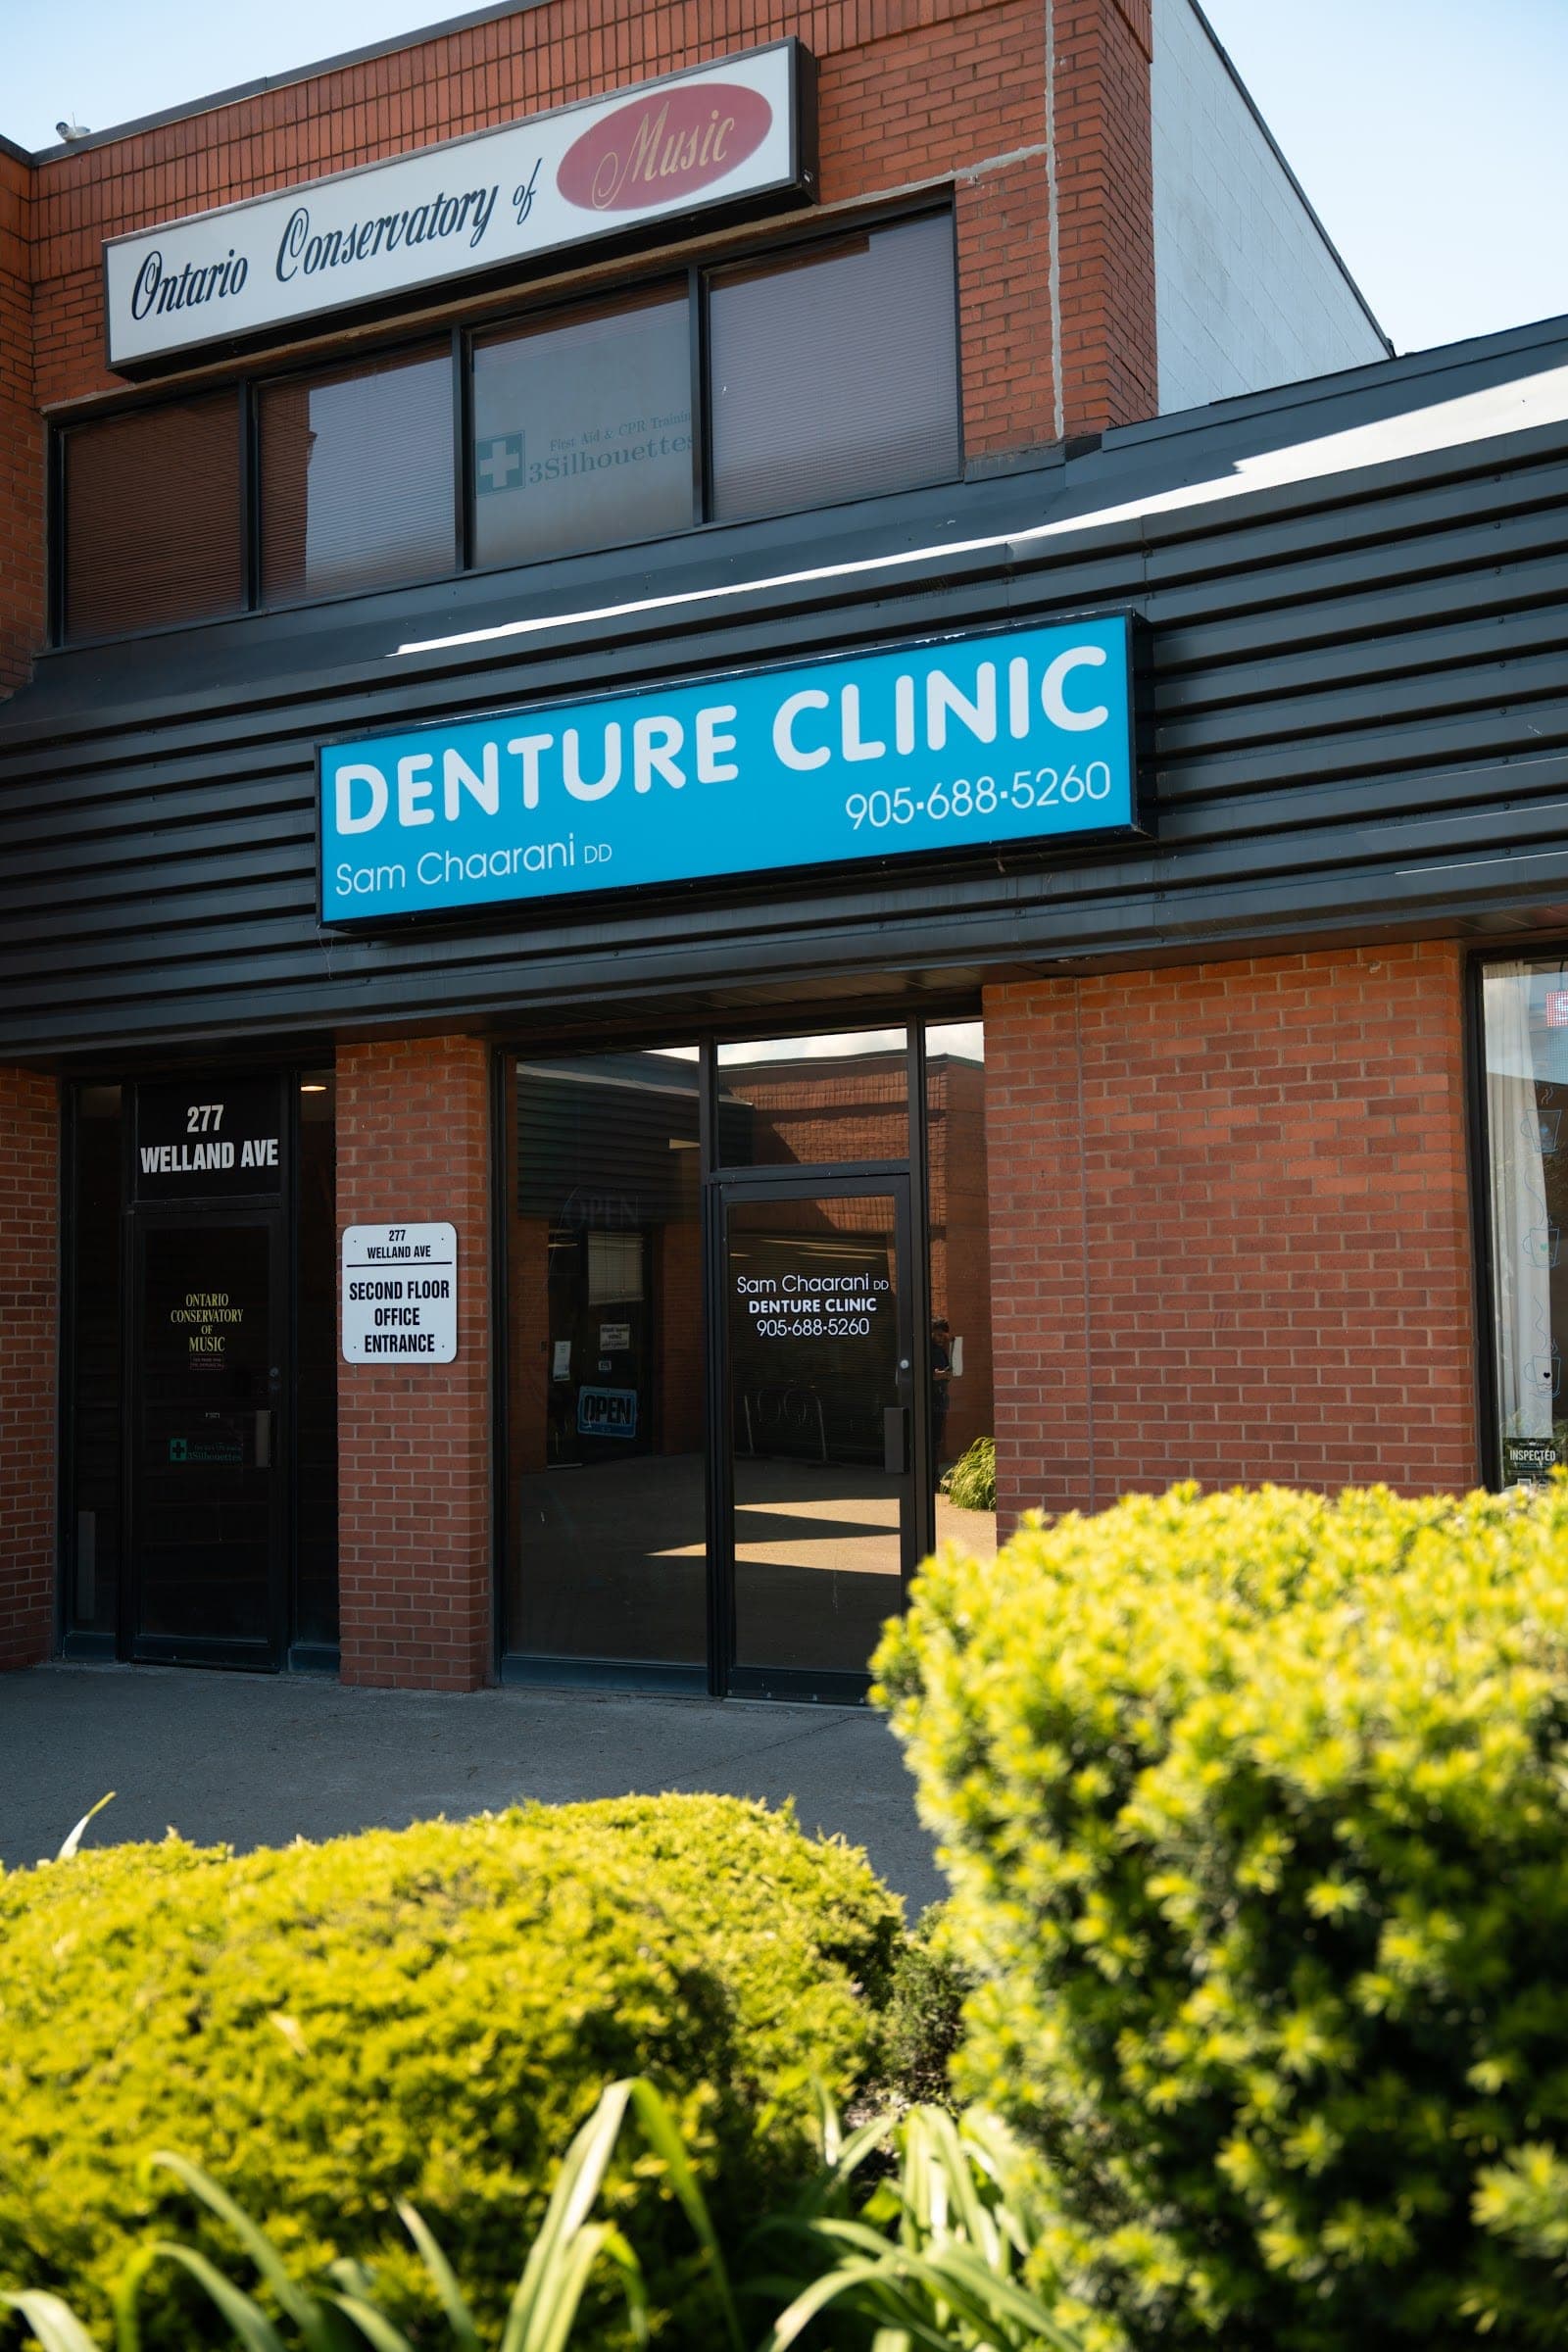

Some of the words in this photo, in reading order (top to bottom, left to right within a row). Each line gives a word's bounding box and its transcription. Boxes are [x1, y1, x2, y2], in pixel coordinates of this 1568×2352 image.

[130, 249, 249, 321] Ontario
[275, 184, 500, 282] Conservatory
[513, 158, 543, 225] of
[591, 100, 735, 210] Music
[549, 437, 575, 452] First
[580, 428, 600, 445] Aid
[603, 429, 614, 440] &
[618, 418, 647, 436] CPR
[650, 410, 691, 430] Trainin
[335, 705, 740, 835] DENTURE
[772, 646, 1109, 771] CLINIC
[336, 863, 406, 896] Sam
[417, 833, 574, 885] Chaarani
[583, 843, 612, 863] DD
[186, 1103, 224, 1133] 277
[140, 1142, 235, 1174] WELLAND
[240, 1138, 279, 1168] AVE
[388, 1229, 407, 1242] 277
[368, 1246, 412, 1259] WELLAND
[414, 1245, 431, 1257] AVE
[349, 1281, 403, 1300] SECOND
[407, 1280, 450, 1299] FLOOR
[737, 1276, 777, 1294] Sam
[782, 1272, 869, 1293] Chaarani
[873, 1279, 890, 1291] DD
[185, 1293, 229, 1307] ONTARIO
[749, 1298, 821, 1314] DENTURE
[825, 1297, 877, 1313] CLINIC
[171, 1308, 244, 1323] CONSERVATORY
[374, 1307, 420, 1327] OFFICE
[201, 1324, 214, 1335] OF
[188, 1336, 225, 1352] MUSIC
[364, 1334, 435, 1353] ENTRANCE
[583, 1395, 631, 1425] OPEN
[1509, 1449, 1556, 1462] INSPECTED
